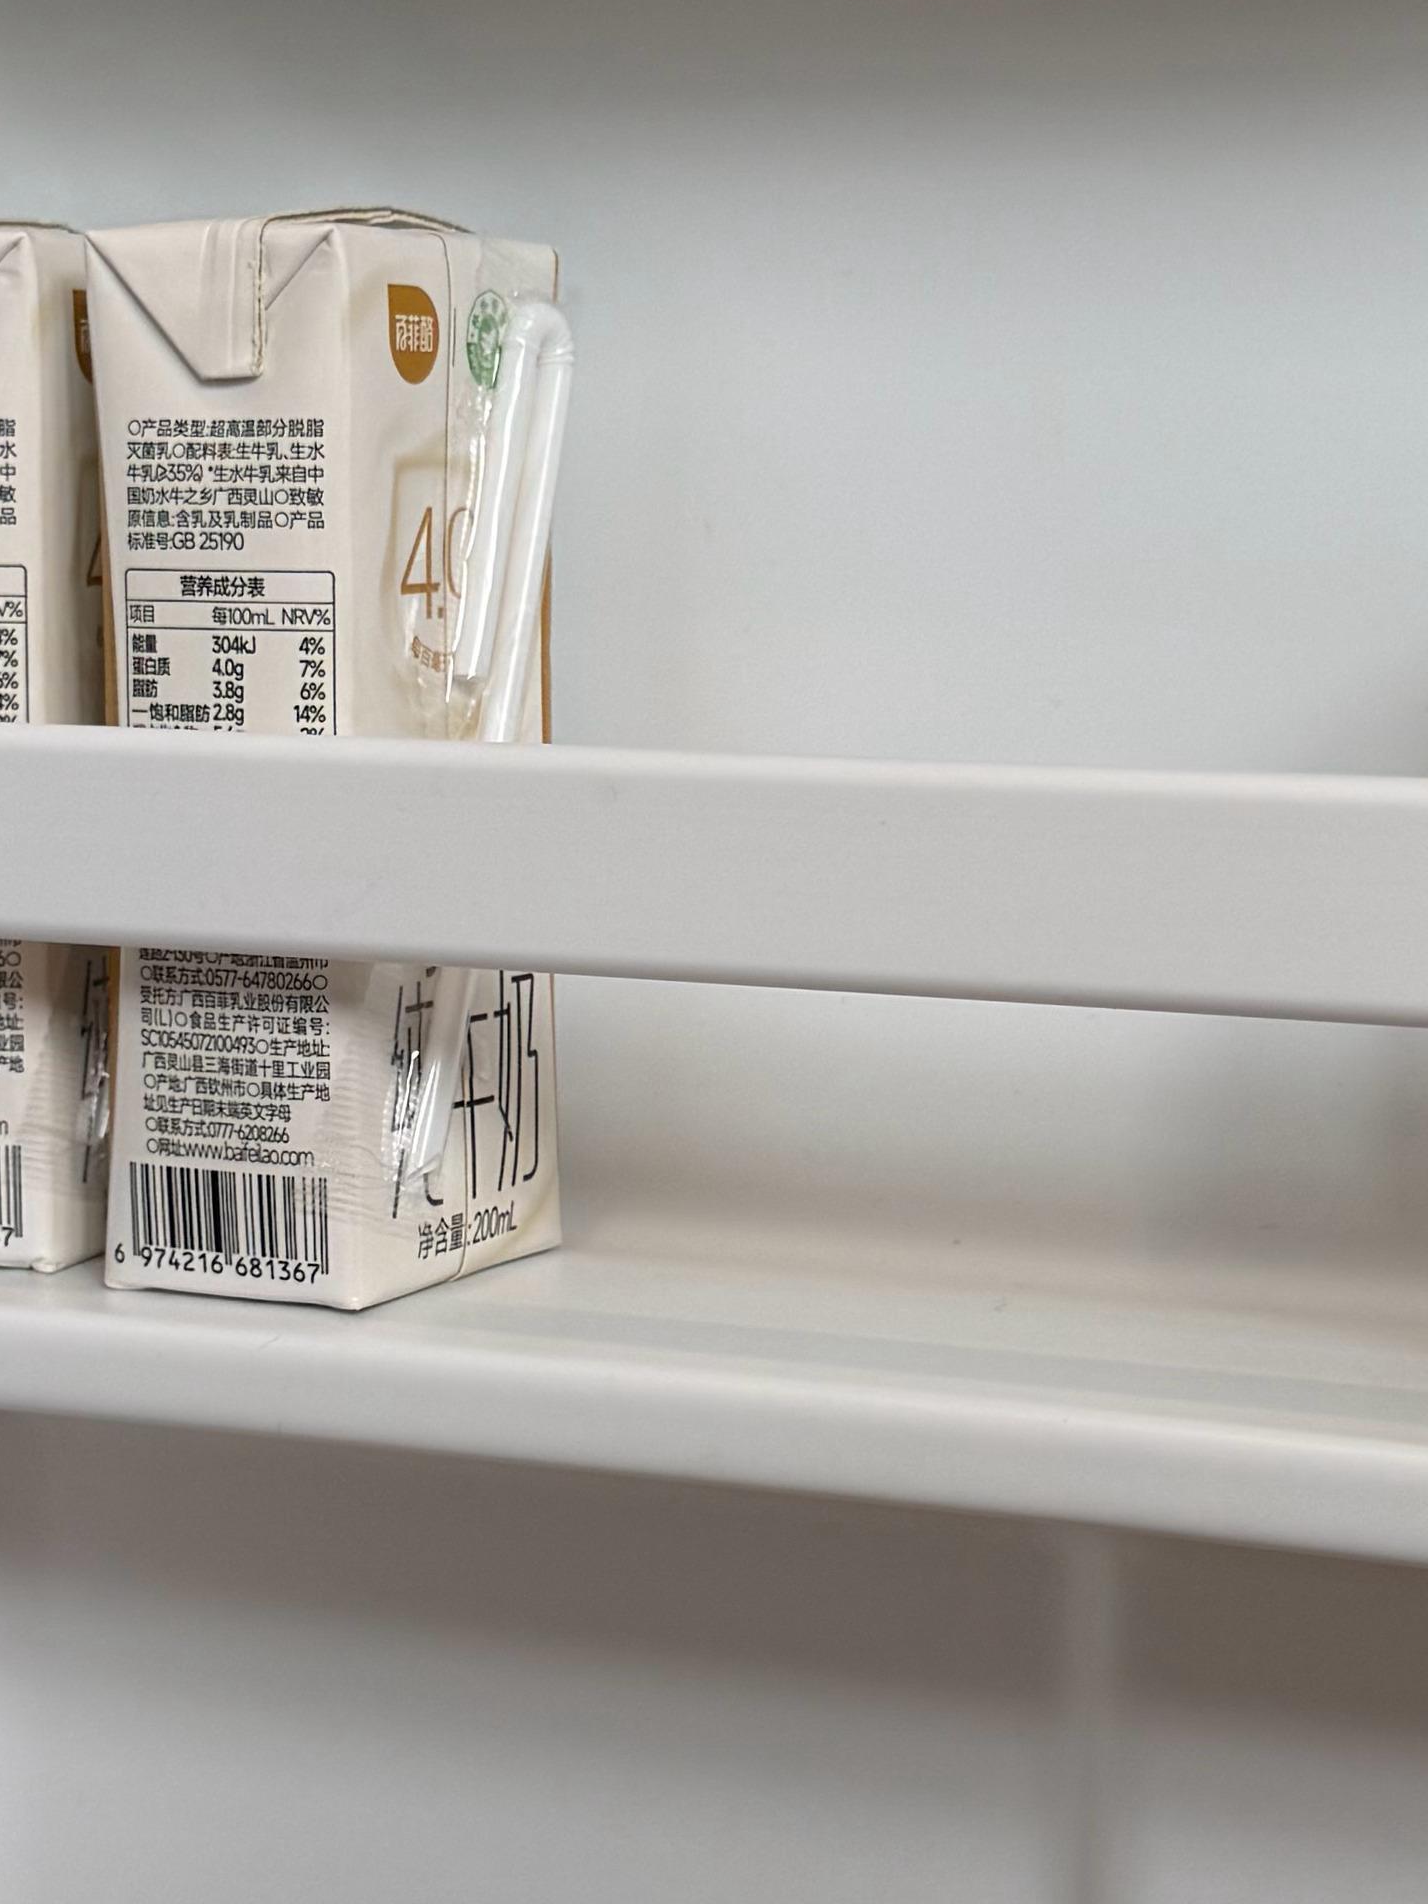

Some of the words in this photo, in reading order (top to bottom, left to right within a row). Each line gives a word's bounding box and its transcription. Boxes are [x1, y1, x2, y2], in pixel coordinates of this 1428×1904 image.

[200, 532, 244, 551] 25190
[181, 575, 265, 597] 营养成分表
[129, 605, 155, 624] 项目
[212, 607, 275, 626] 每100mL
[282, 608, 331, 626] NRV%
[132, 634, 157, 654] 能量
[212, 635, 257, 654] 304kJ
[299, 636, 326, 655] 4%
[132, 657, 171, 676] 蛋白质
[212, 658, 244, 680] 4.0g
[299, 660, 326, 678] 7%
[132, 679, 158, 698] 脂肪
[213, 681, 244, 703] 3.8g
[300, 682, 326, 701] 6%
[213, 703, 244, 726] 2.8g
[294, 705, 326, 724] 14%
[143, 1051, 331, 1080] 广西灵山县三海街道十里工业园
[418, 1201, 518, 1259] 净含量:200mL
[115, 1243, 125, 1263] 6
[142, 1247, 223, 1274] 974216
[236, 1258, 319, 1283] 681367
